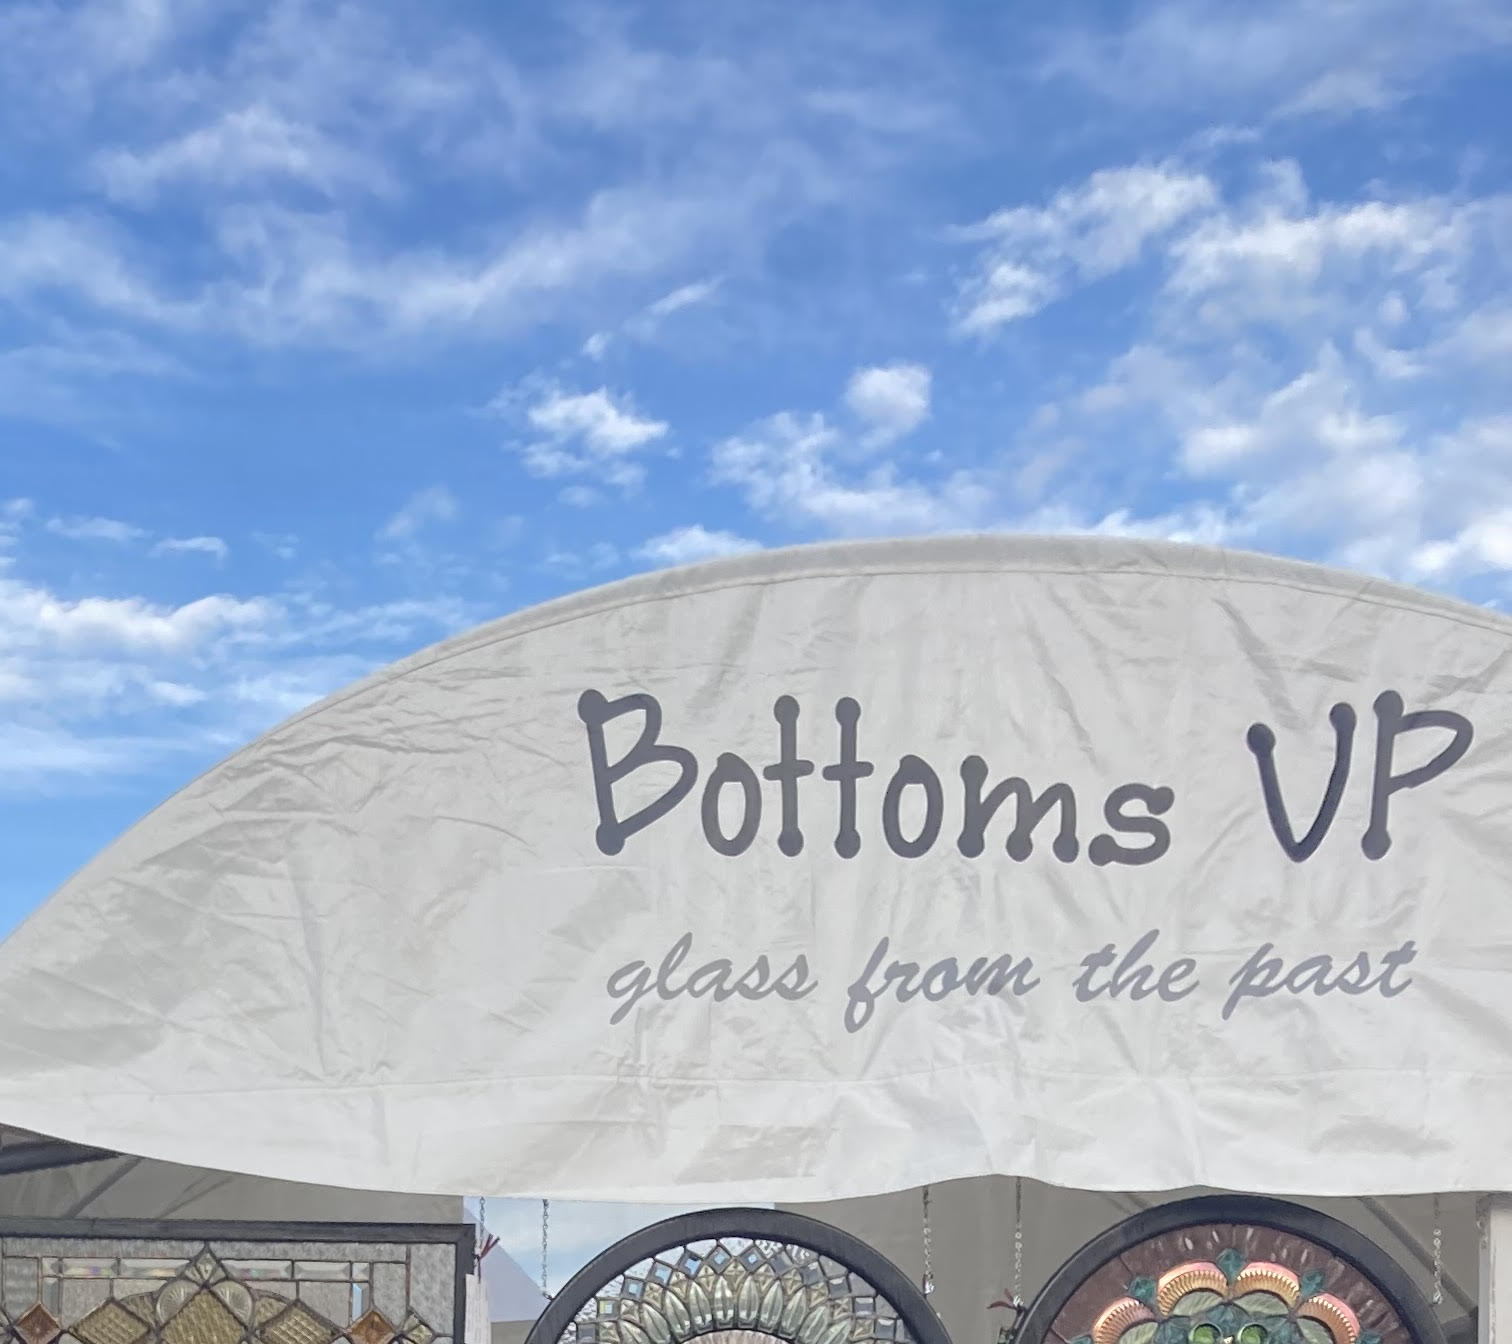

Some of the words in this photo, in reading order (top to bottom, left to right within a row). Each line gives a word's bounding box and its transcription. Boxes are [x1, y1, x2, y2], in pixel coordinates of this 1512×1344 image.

[577, 689, 1176, 865] Bottoms
[606, 932, 818, 1025] glass
[847, 937, 1041, 1033] from
[1071, 929, 1198, 1000] the
[1222, 938, 1418, 1020] past
